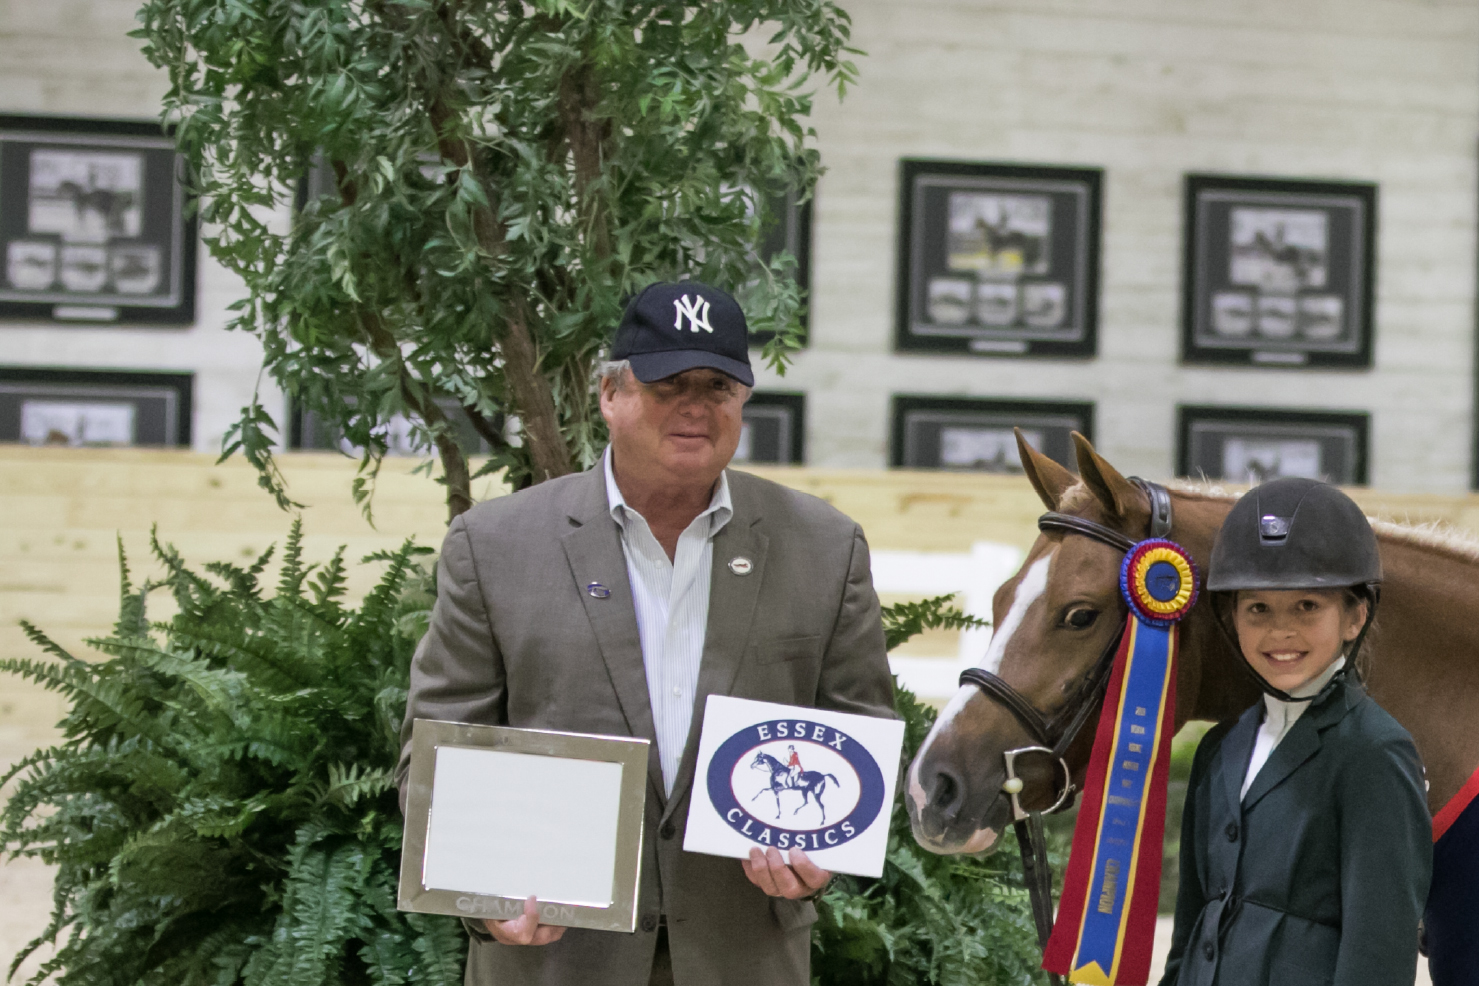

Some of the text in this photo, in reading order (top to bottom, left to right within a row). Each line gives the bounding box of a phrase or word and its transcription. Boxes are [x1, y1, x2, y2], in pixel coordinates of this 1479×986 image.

[673, 294, 713, 333] NY
[757, 722, 847, 750] ESSEX
[726, 808, 855, 849] CLASSICS
[456, 896, 575, 919] CHAMON
